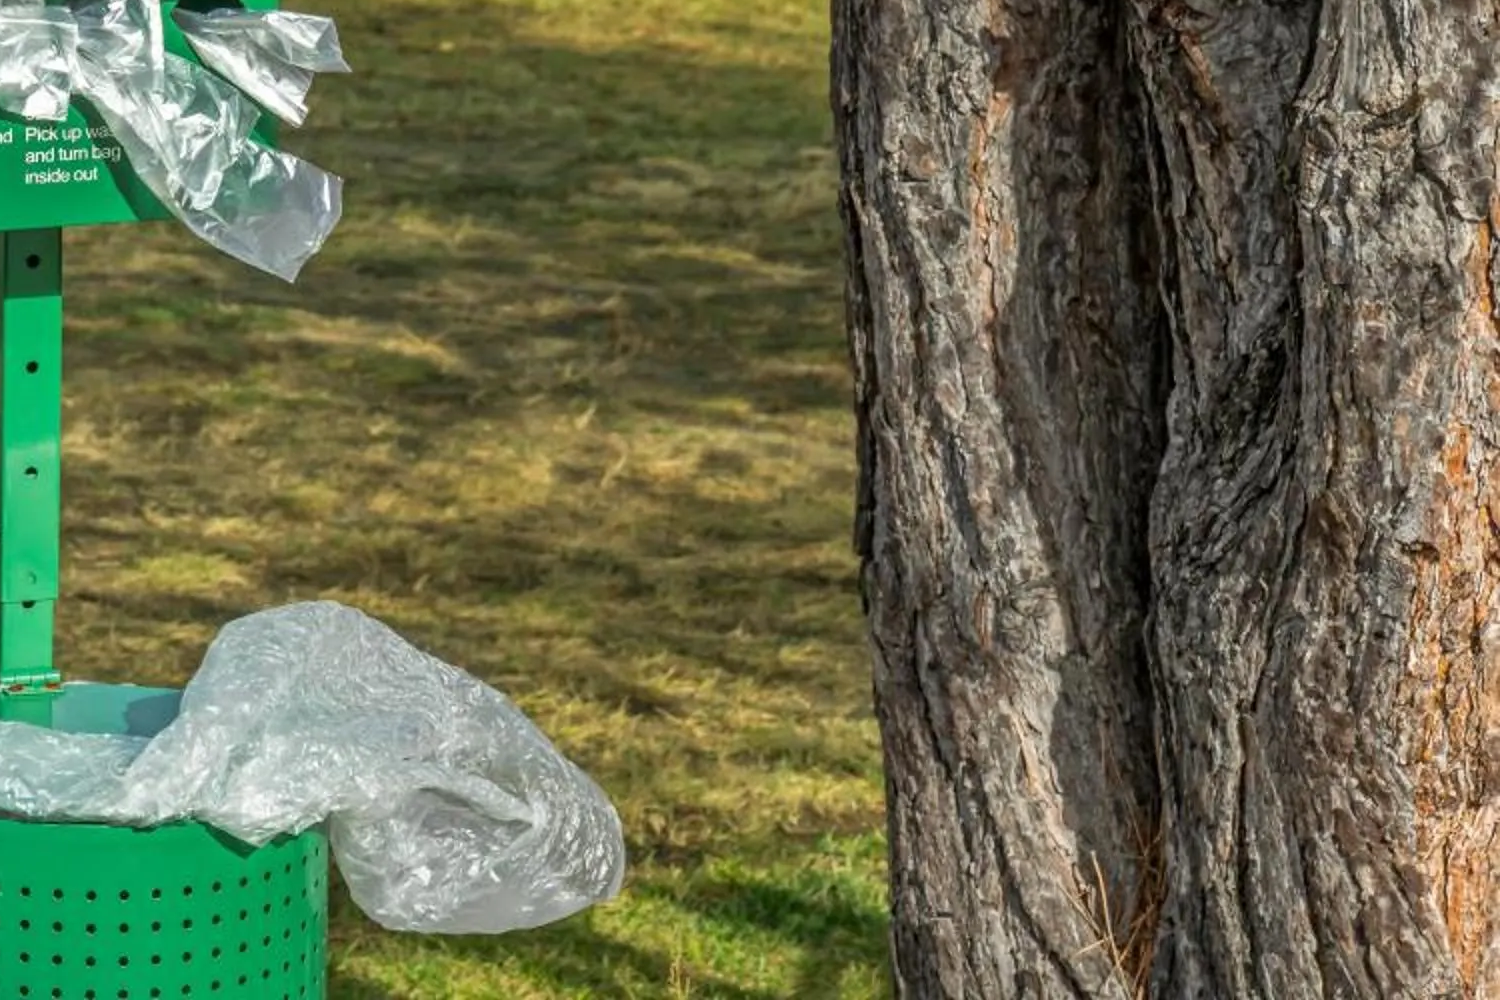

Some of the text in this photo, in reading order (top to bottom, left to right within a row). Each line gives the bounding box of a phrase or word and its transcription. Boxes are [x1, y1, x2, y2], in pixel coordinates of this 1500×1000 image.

[25, 126, 59, 143] Pick
[61, 127, 83, 143] up
[25, 144, 121, 164] and turn bag
[25, 167, 99, 185] inside out
